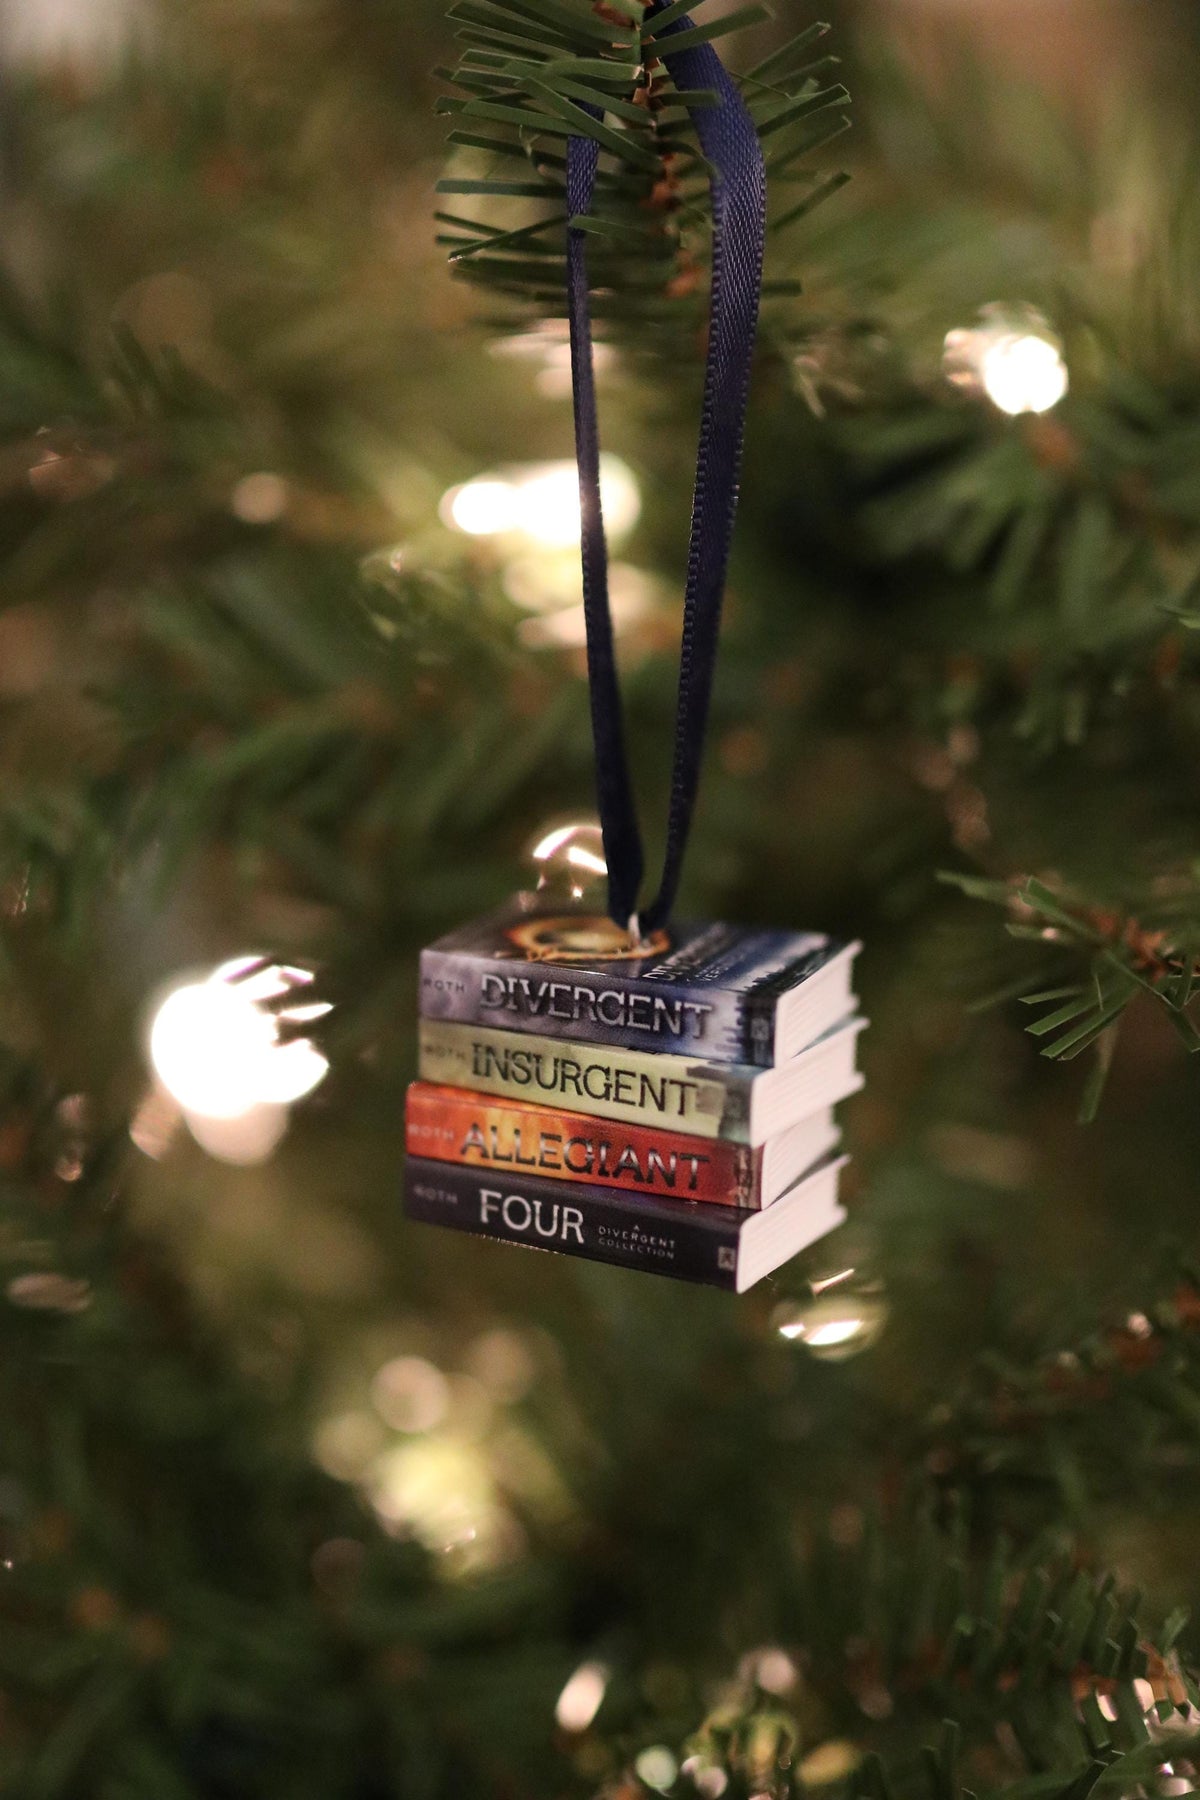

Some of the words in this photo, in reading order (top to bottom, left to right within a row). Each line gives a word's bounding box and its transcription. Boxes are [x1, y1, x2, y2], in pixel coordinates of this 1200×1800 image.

[480, 972, 713, 1040] DIVERGENT
[472, 1042, 702, 1116] INSURGENT
[460, 1122, 711, 1191] ALLEGIANT
[478, 1187, 586, 1244] FOUR
[598, 1225, 676, 1249] DIVERGENT
[598, 1237, 675, 1260] COLLECTION
